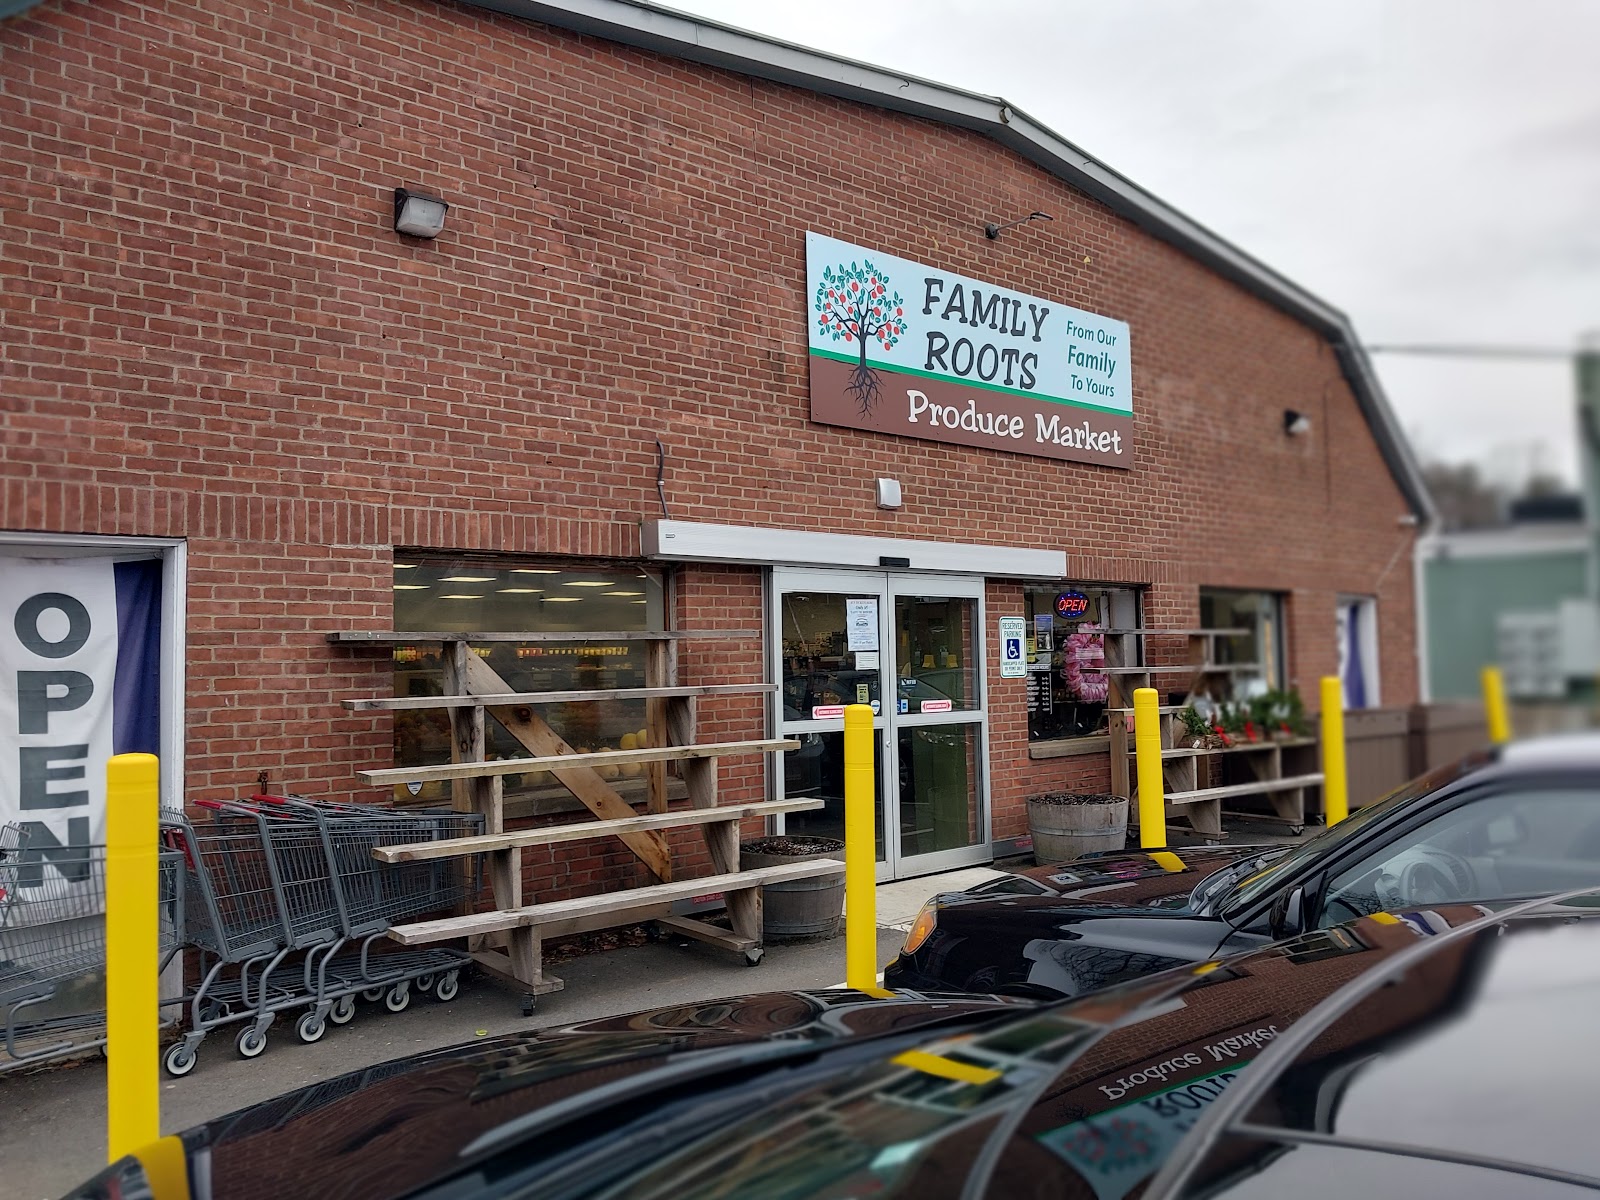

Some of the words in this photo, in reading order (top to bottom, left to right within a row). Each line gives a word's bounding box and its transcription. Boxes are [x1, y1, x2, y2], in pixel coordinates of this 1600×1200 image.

[922, 277, 1049, 342] FAMILY
[1066, 320, 1095, 344] From
[1097, 328, 1117, 347] Our
[924, 331, 1038, 390] ROOTS
[1067, 344, 1117, 379] Family
[1071, 374, 1083, 391] To
[1085, 376, 1115, 398] Yours
[906, 389, 1024, 439] Produce
[1034, 413, 1123, 455] Market
[1058, 599, 1088, 611] OPEN
[1002, 622, 1023, 630] RESERVED
[14, 592, 94, 888] OPEN
